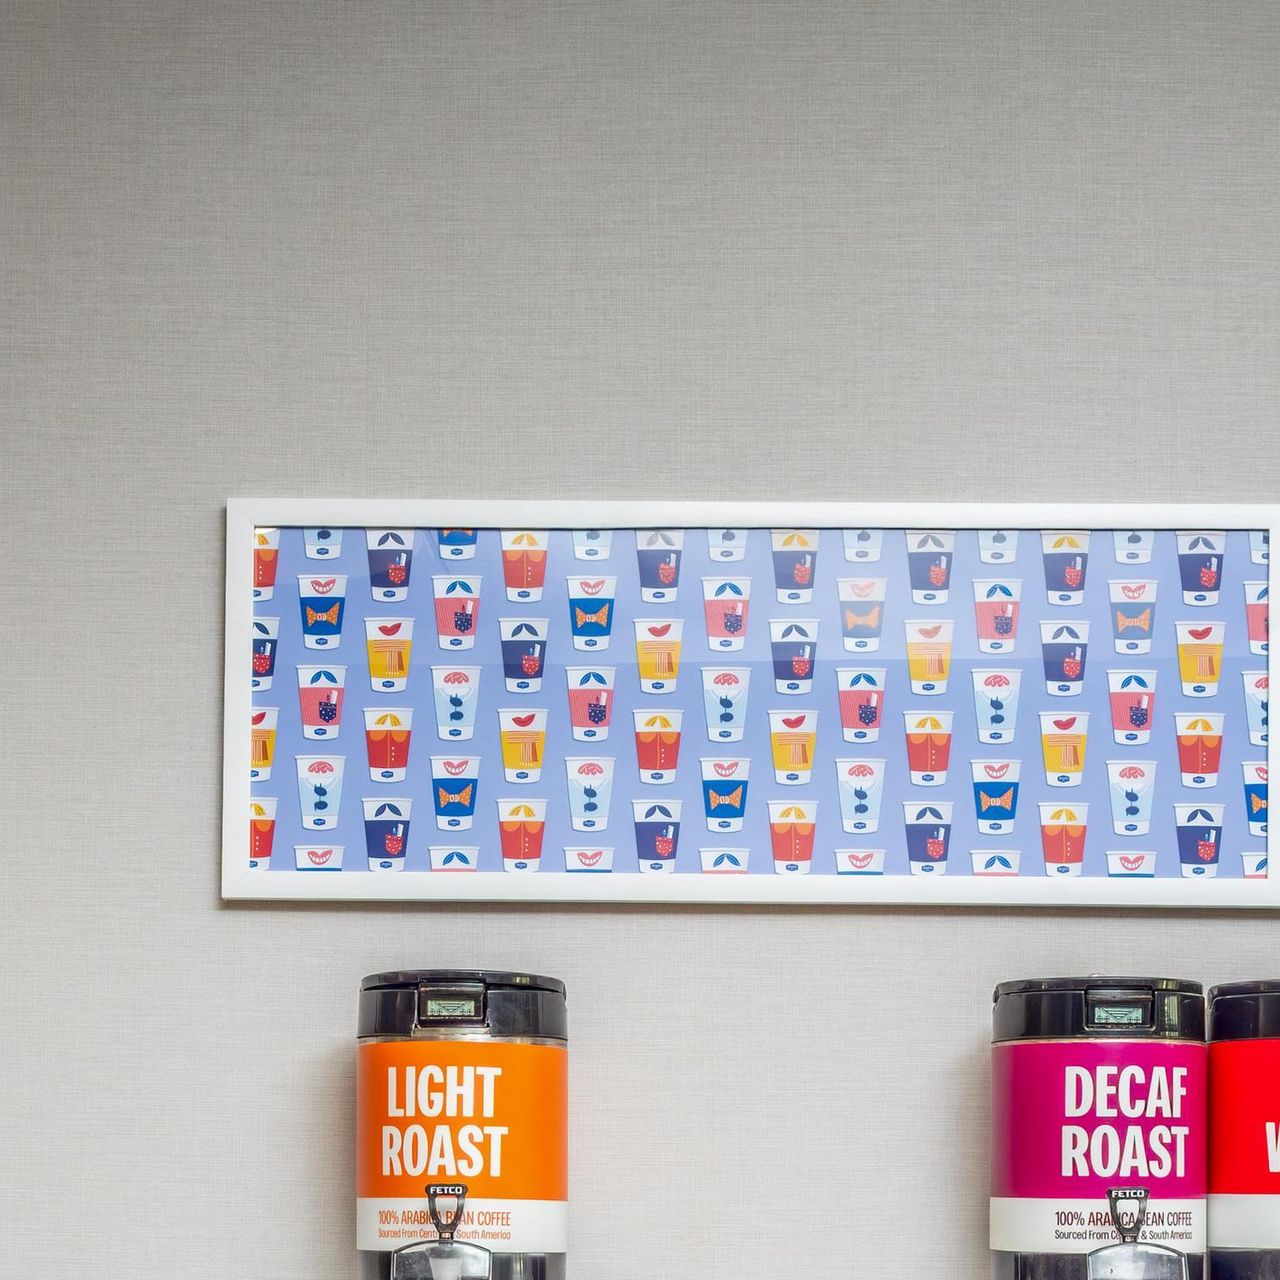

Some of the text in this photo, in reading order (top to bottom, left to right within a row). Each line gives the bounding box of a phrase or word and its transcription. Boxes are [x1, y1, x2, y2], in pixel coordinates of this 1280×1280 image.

[387, 1064, 503, 1118] LIGHT
[1064, 1064, 1188, 1118] DECAF
[382, 1123, 509, 1177] ROAST
[1061, 1124, 1190, 1178] ROAST
[430, 1186, 463, 1195] FETCO
[1112, 1190, 1145, 1198] FETCO
[378, 1210, 399, 1225] 100%
[445, 1211, 474, 1226] BAN
[477, 1211, 511, 1226] COFFEE
[1055, 1211, 1085, 1226] 100%
[1088, 1211, 1137, 1227] ARAICA
[1167, 1211, 1192, 1226] COFFEE
[378, 1228, 511, 1240] Sourced From Centr South America
[1055, 1230, 1087, 1240] Sourced
[1089, 1230, 1110, 1240] From
[1140, 1231, 1148, 1240] &
[1149, 1230, 1170, 1240] South
[1170, 1230, 1193, 1240] America
